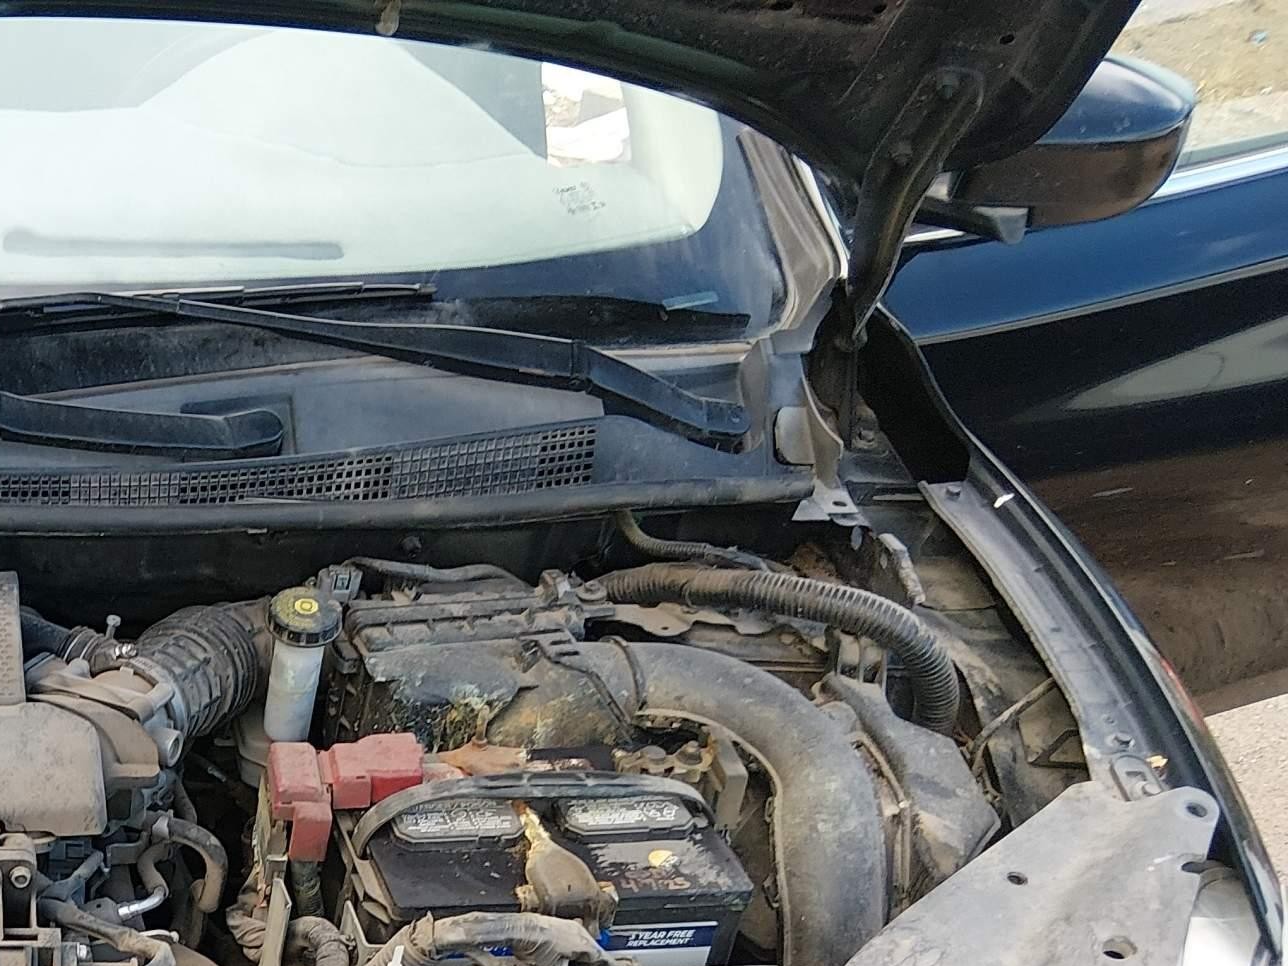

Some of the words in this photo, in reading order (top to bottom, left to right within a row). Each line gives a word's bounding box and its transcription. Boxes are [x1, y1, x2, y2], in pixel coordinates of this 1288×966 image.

[638, 930, 666, 939] YEAR
[666, 929, 696, 938] FREE
[626, 938, 690, 947] REPLACEMENT
